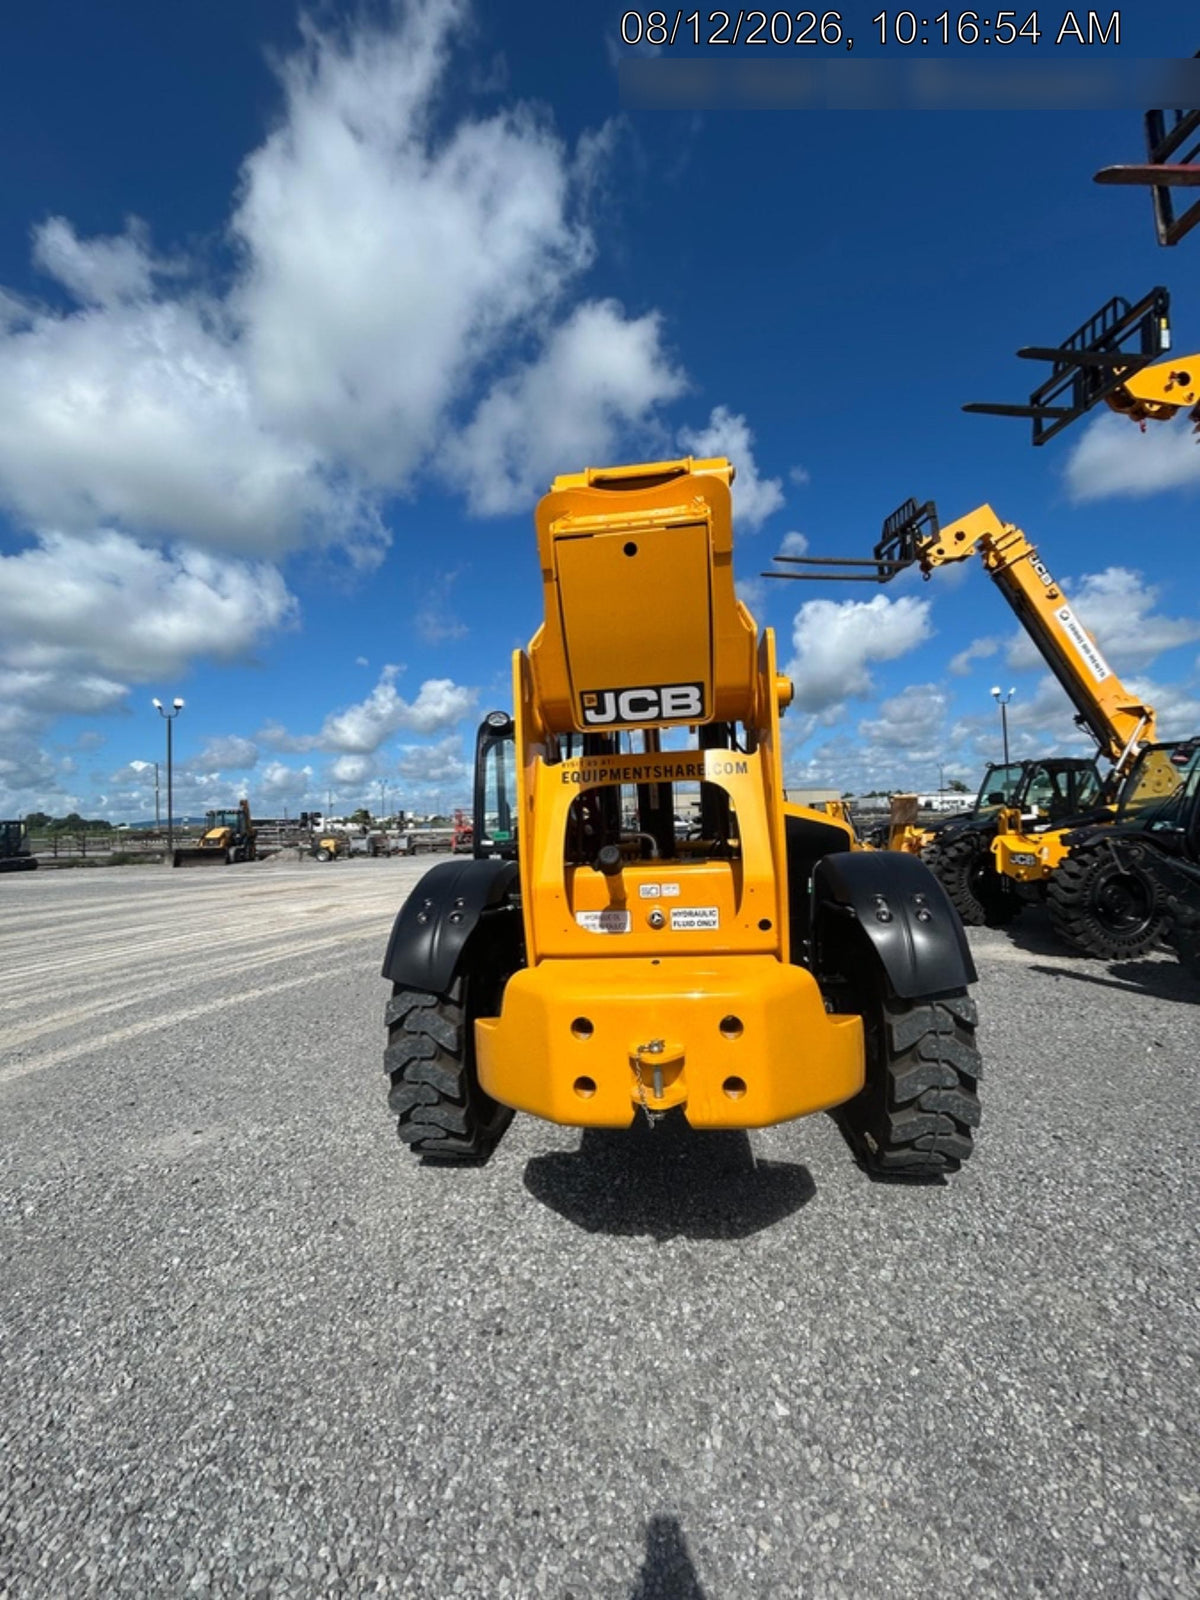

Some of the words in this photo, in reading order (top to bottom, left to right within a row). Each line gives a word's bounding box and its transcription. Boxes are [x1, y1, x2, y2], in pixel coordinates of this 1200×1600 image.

[1028, 552, 1053, 587] JCB
[584, 686, 702, 723] JCB
[1010, 854, 1036, 866] JCB
[672, 909, 717, 918] HYDRAULIC
[673, 919, 696, 928] FLUID
[697, 919, 717, 928] ONLY
